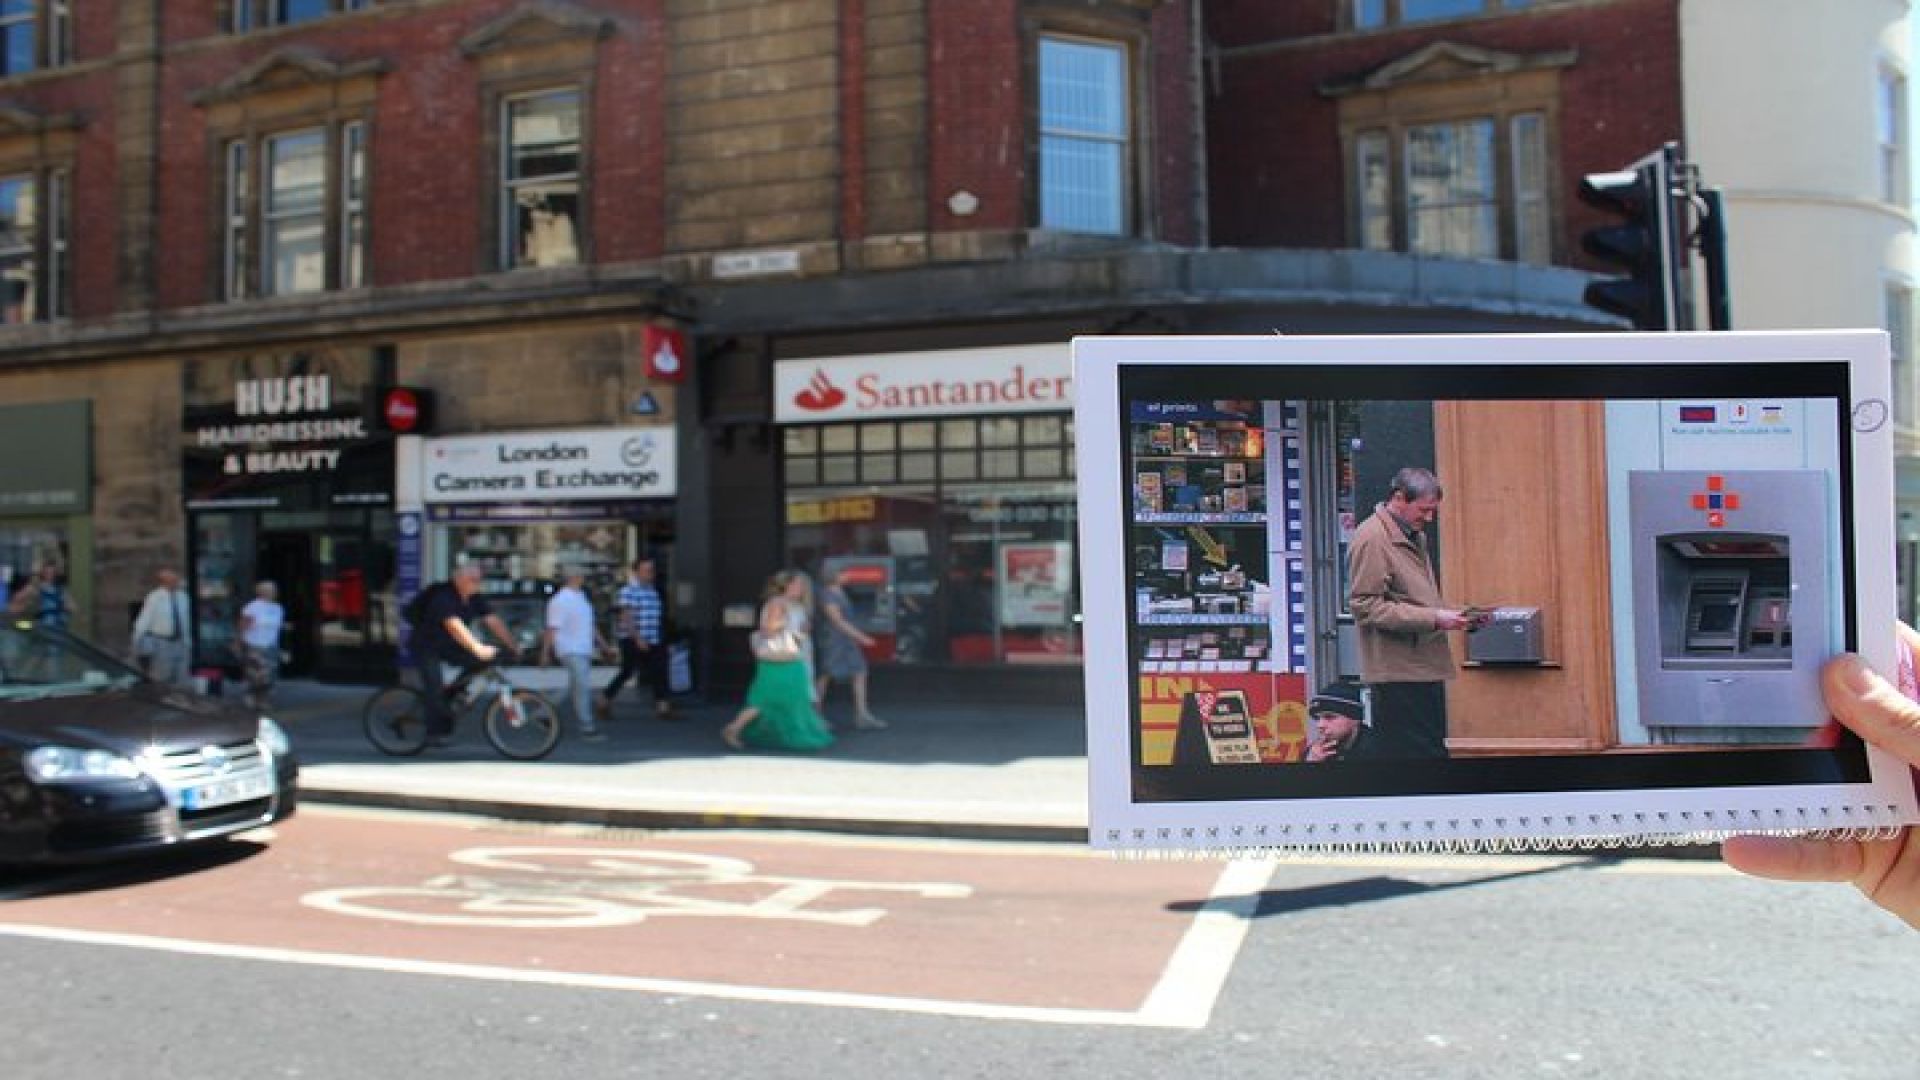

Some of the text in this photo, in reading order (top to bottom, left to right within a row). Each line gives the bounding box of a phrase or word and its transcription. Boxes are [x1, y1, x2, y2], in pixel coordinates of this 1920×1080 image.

[236, 375, 331, 416] HUSH
[855, 365, 1071, 411] Santander
[223, 449, 341, 474] & BEAUTY
[498, 441, 589, 464] London
[433, 468, 659, 492] Camera Exchange
